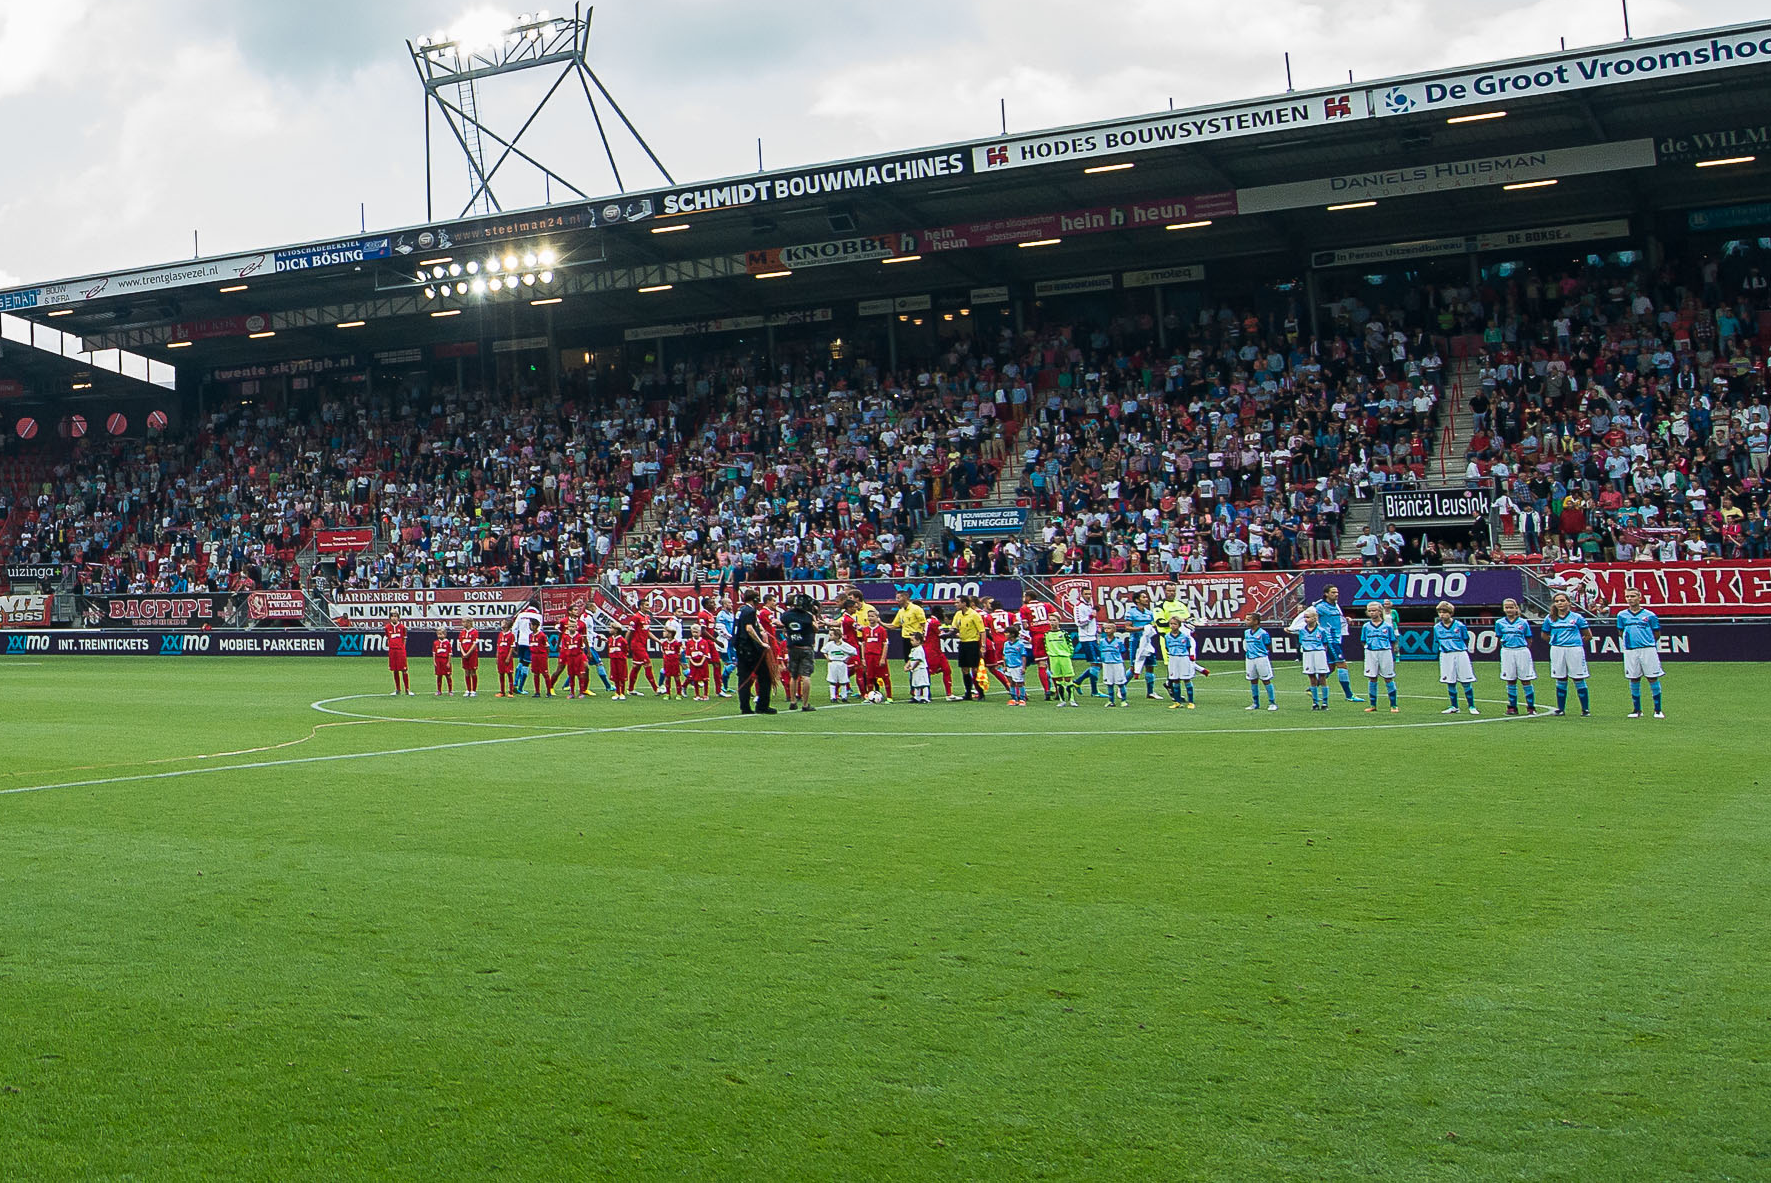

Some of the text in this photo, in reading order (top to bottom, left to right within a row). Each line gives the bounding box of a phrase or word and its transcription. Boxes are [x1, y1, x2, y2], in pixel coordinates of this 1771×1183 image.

[1425, 83, 1466, 104] De
[1473, 64, 1569, 95] Groot
[1020, 105, 1309, 161] HODES BOUWSYSTEMEN
[1660, 138, 1689, 154] de
[1331, 154, 1546, 191] DANIELS HUISMAN
[663, 153, 964, 214] SCHMIDT BOUWMACHINES
[1062, 212, 1105, 232] hein
[1133, 202, 1188, 224] heun
[924, 227, 955, 240] hein
[277, 240, 361, 258] AUTOSCHADEHERSTEL
[785, 236, 893, 262] KNOBBE
[932, 236, 968, 250] heun
[276, 248, 364, 273] DICK BÖSING
[118, 265, 219, 289] www.trentglasvezel.nl
[46, 284, 67, 295] BOUW
[51, 294, 70, 304] INFRA
[214, 365, 267, 380] twente
[1385, 491, 1489, 517] Bianca Leusink
[963, 518, 1018, 528] TEN HEGGELER
[266, 593, 292, 601] FORZA
[336, 591, 503, 603] HARDENBERG BORNE
[8, 611, 44, 622] 1965
[109, 599, 213, 619] BAGPIPE
[268, 609, 303, 617] BELTRUM
[350, 604, 517, 617] IN UNION WE STAND
[1029, 606, 1048, 622] 30
[132, 618, 188, 626] ENSCHEDE
[993, 613, 1010, 630] 24
[58, 638, 149, 651] INT. TREINTICKETS
[219, 638, 325, 651] MOBIEL PARKEREN
[1590, 635, 1690, 654] TAEN
